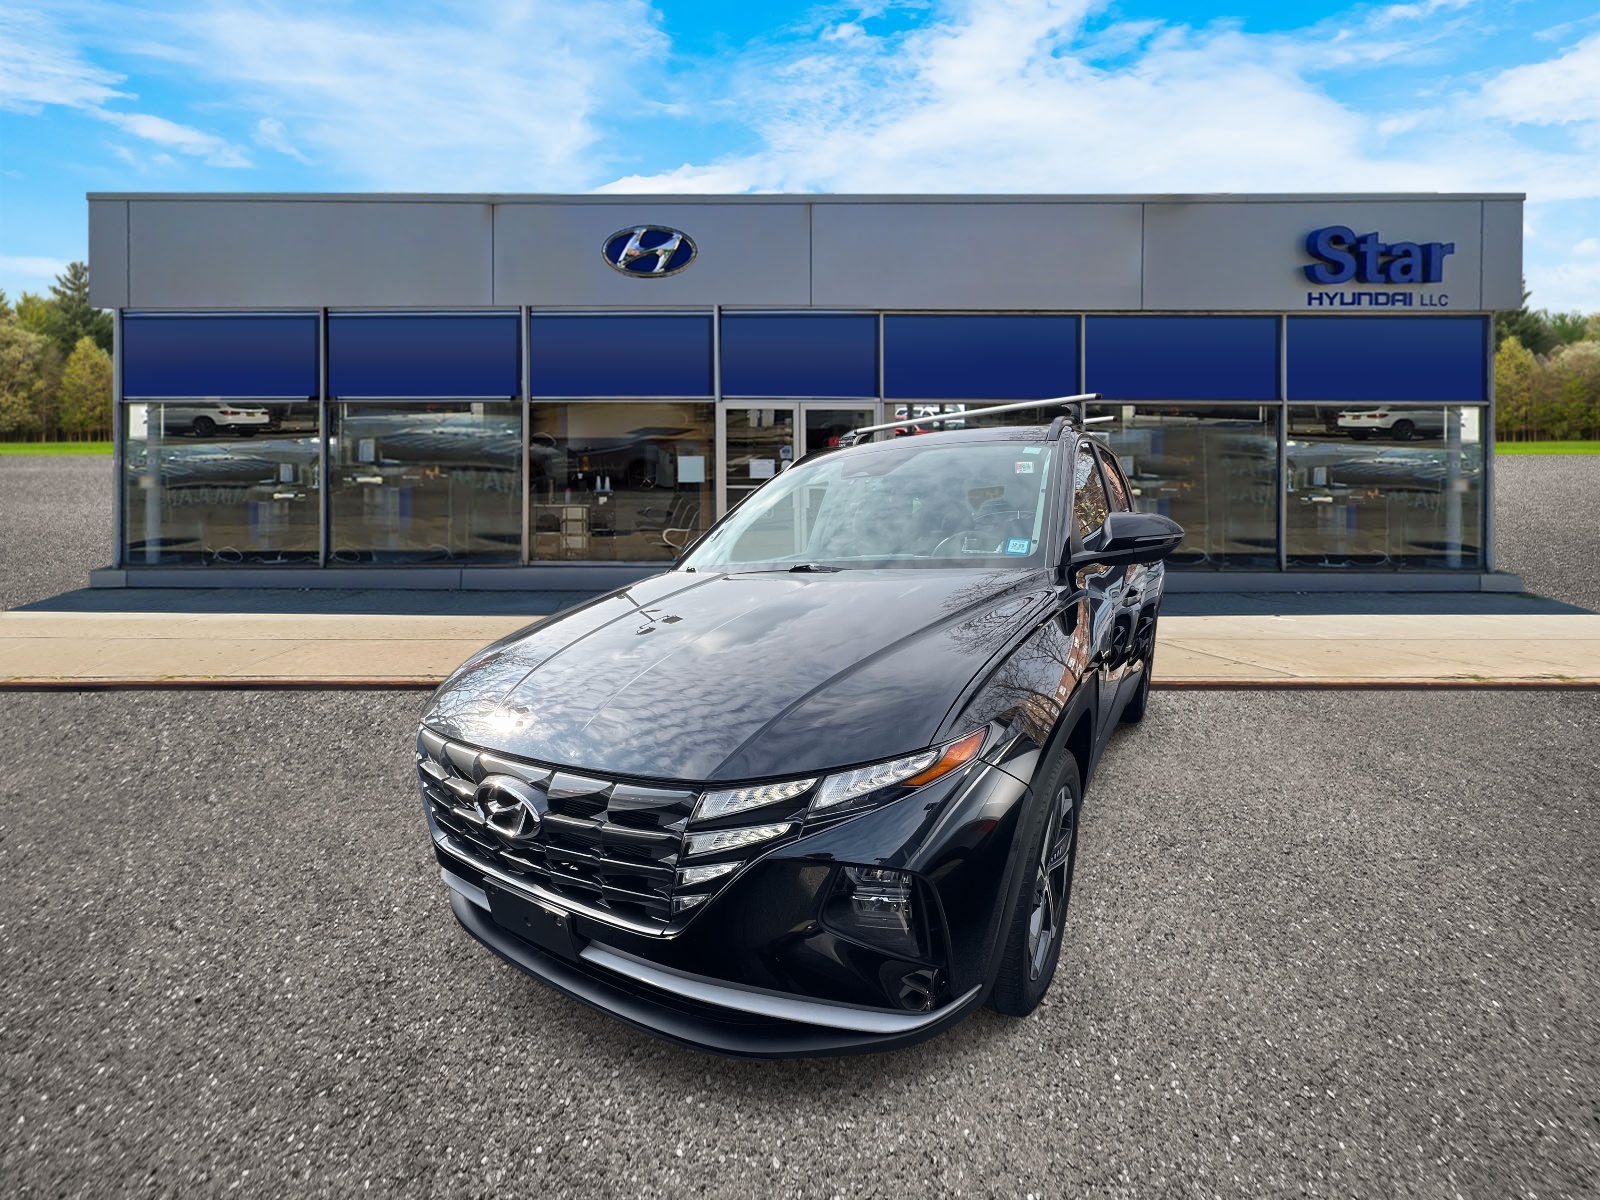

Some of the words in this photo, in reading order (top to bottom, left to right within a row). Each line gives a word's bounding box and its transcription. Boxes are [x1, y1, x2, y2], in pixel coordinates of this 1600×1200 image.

[1303, 226, 1455, 284] Star
[1307, 292, 1413, 306] HYUNDAI
[1420, 294, 1449, 307] LLC
